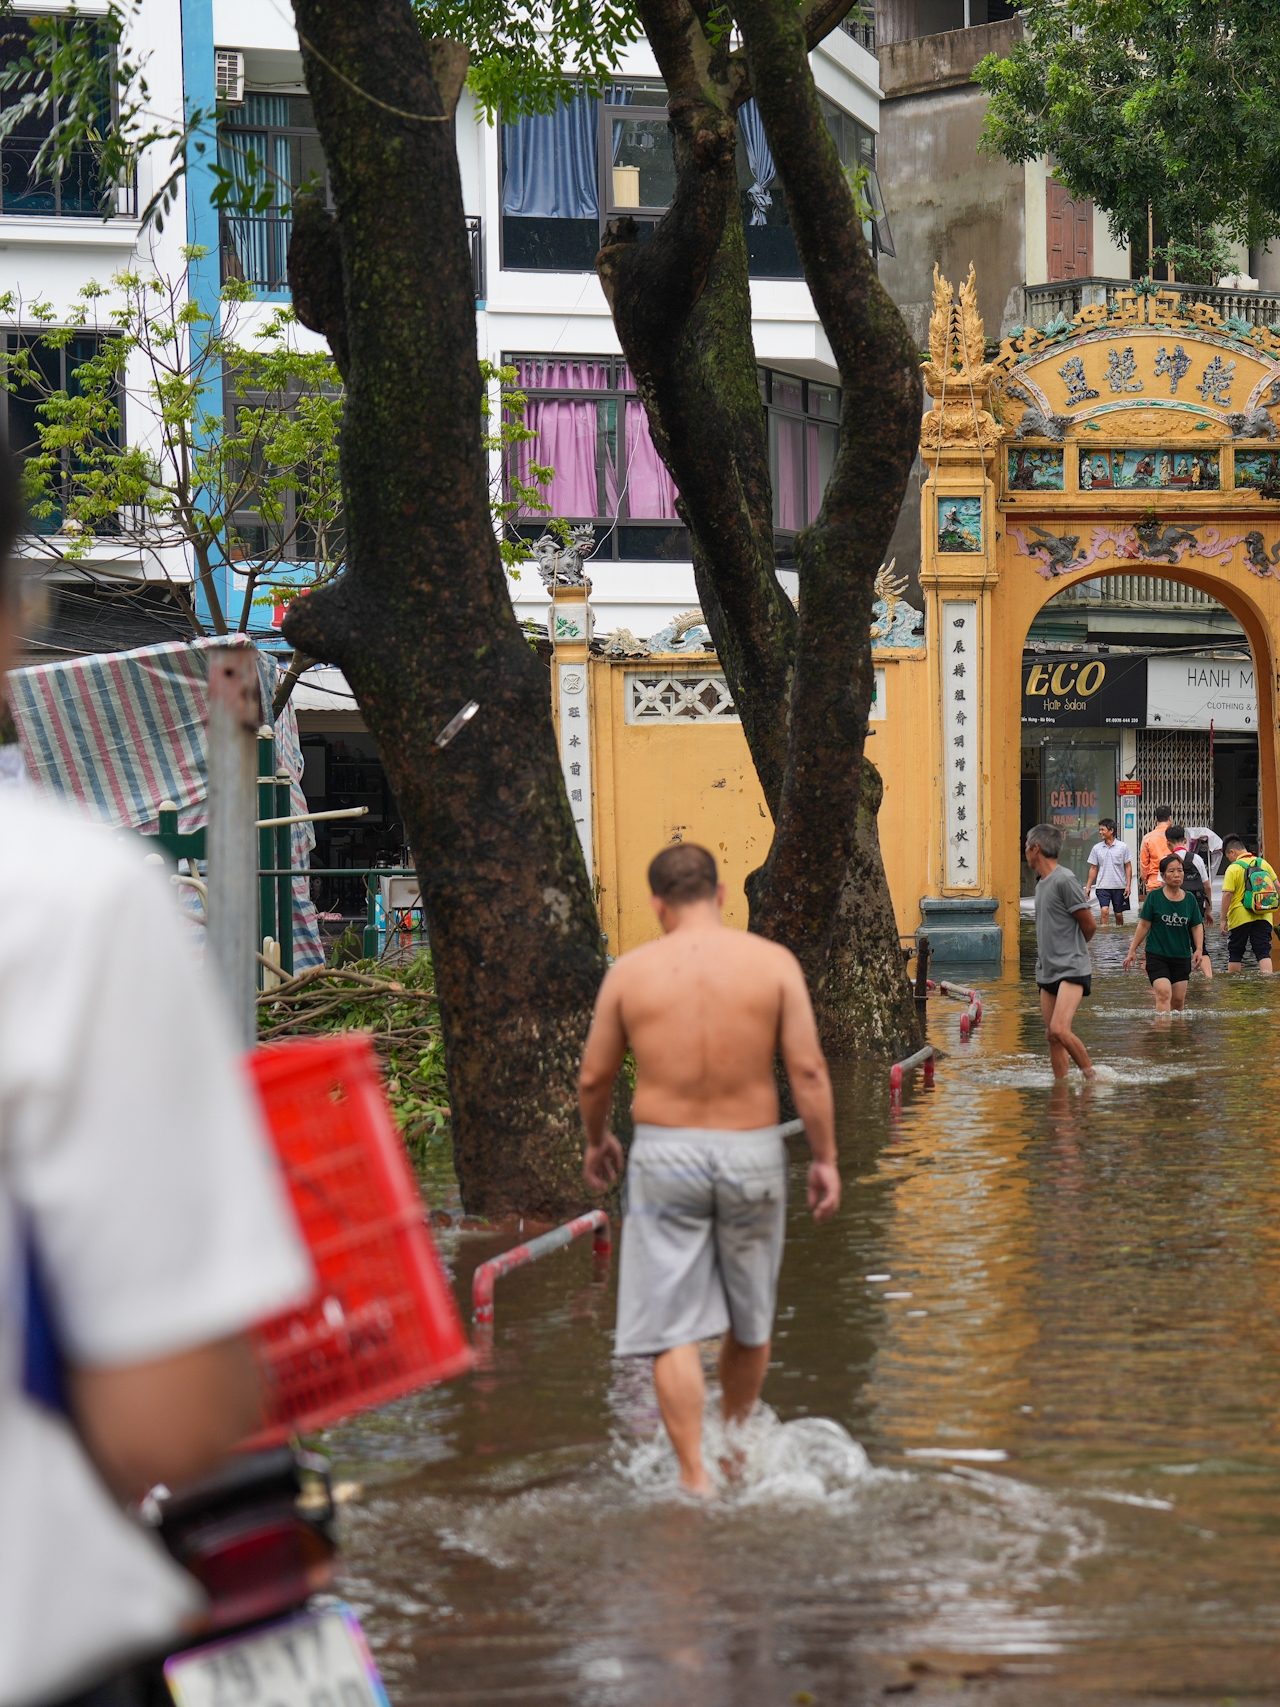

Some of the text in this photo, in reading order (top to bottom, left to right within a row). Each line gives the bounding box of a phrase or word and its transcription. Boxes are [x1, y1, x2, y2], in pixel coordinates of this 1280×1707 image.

[1025, 661, 1106, 696] ECO
[1064, 698, 1086, 711] Salon
[1206, 701, 1244, 711] CLOTHING
[1246, 703, 1252, 711] &
[1051, 784, 1073, 808] CẮT
[1075, 787, 1097, 808] TÓC
